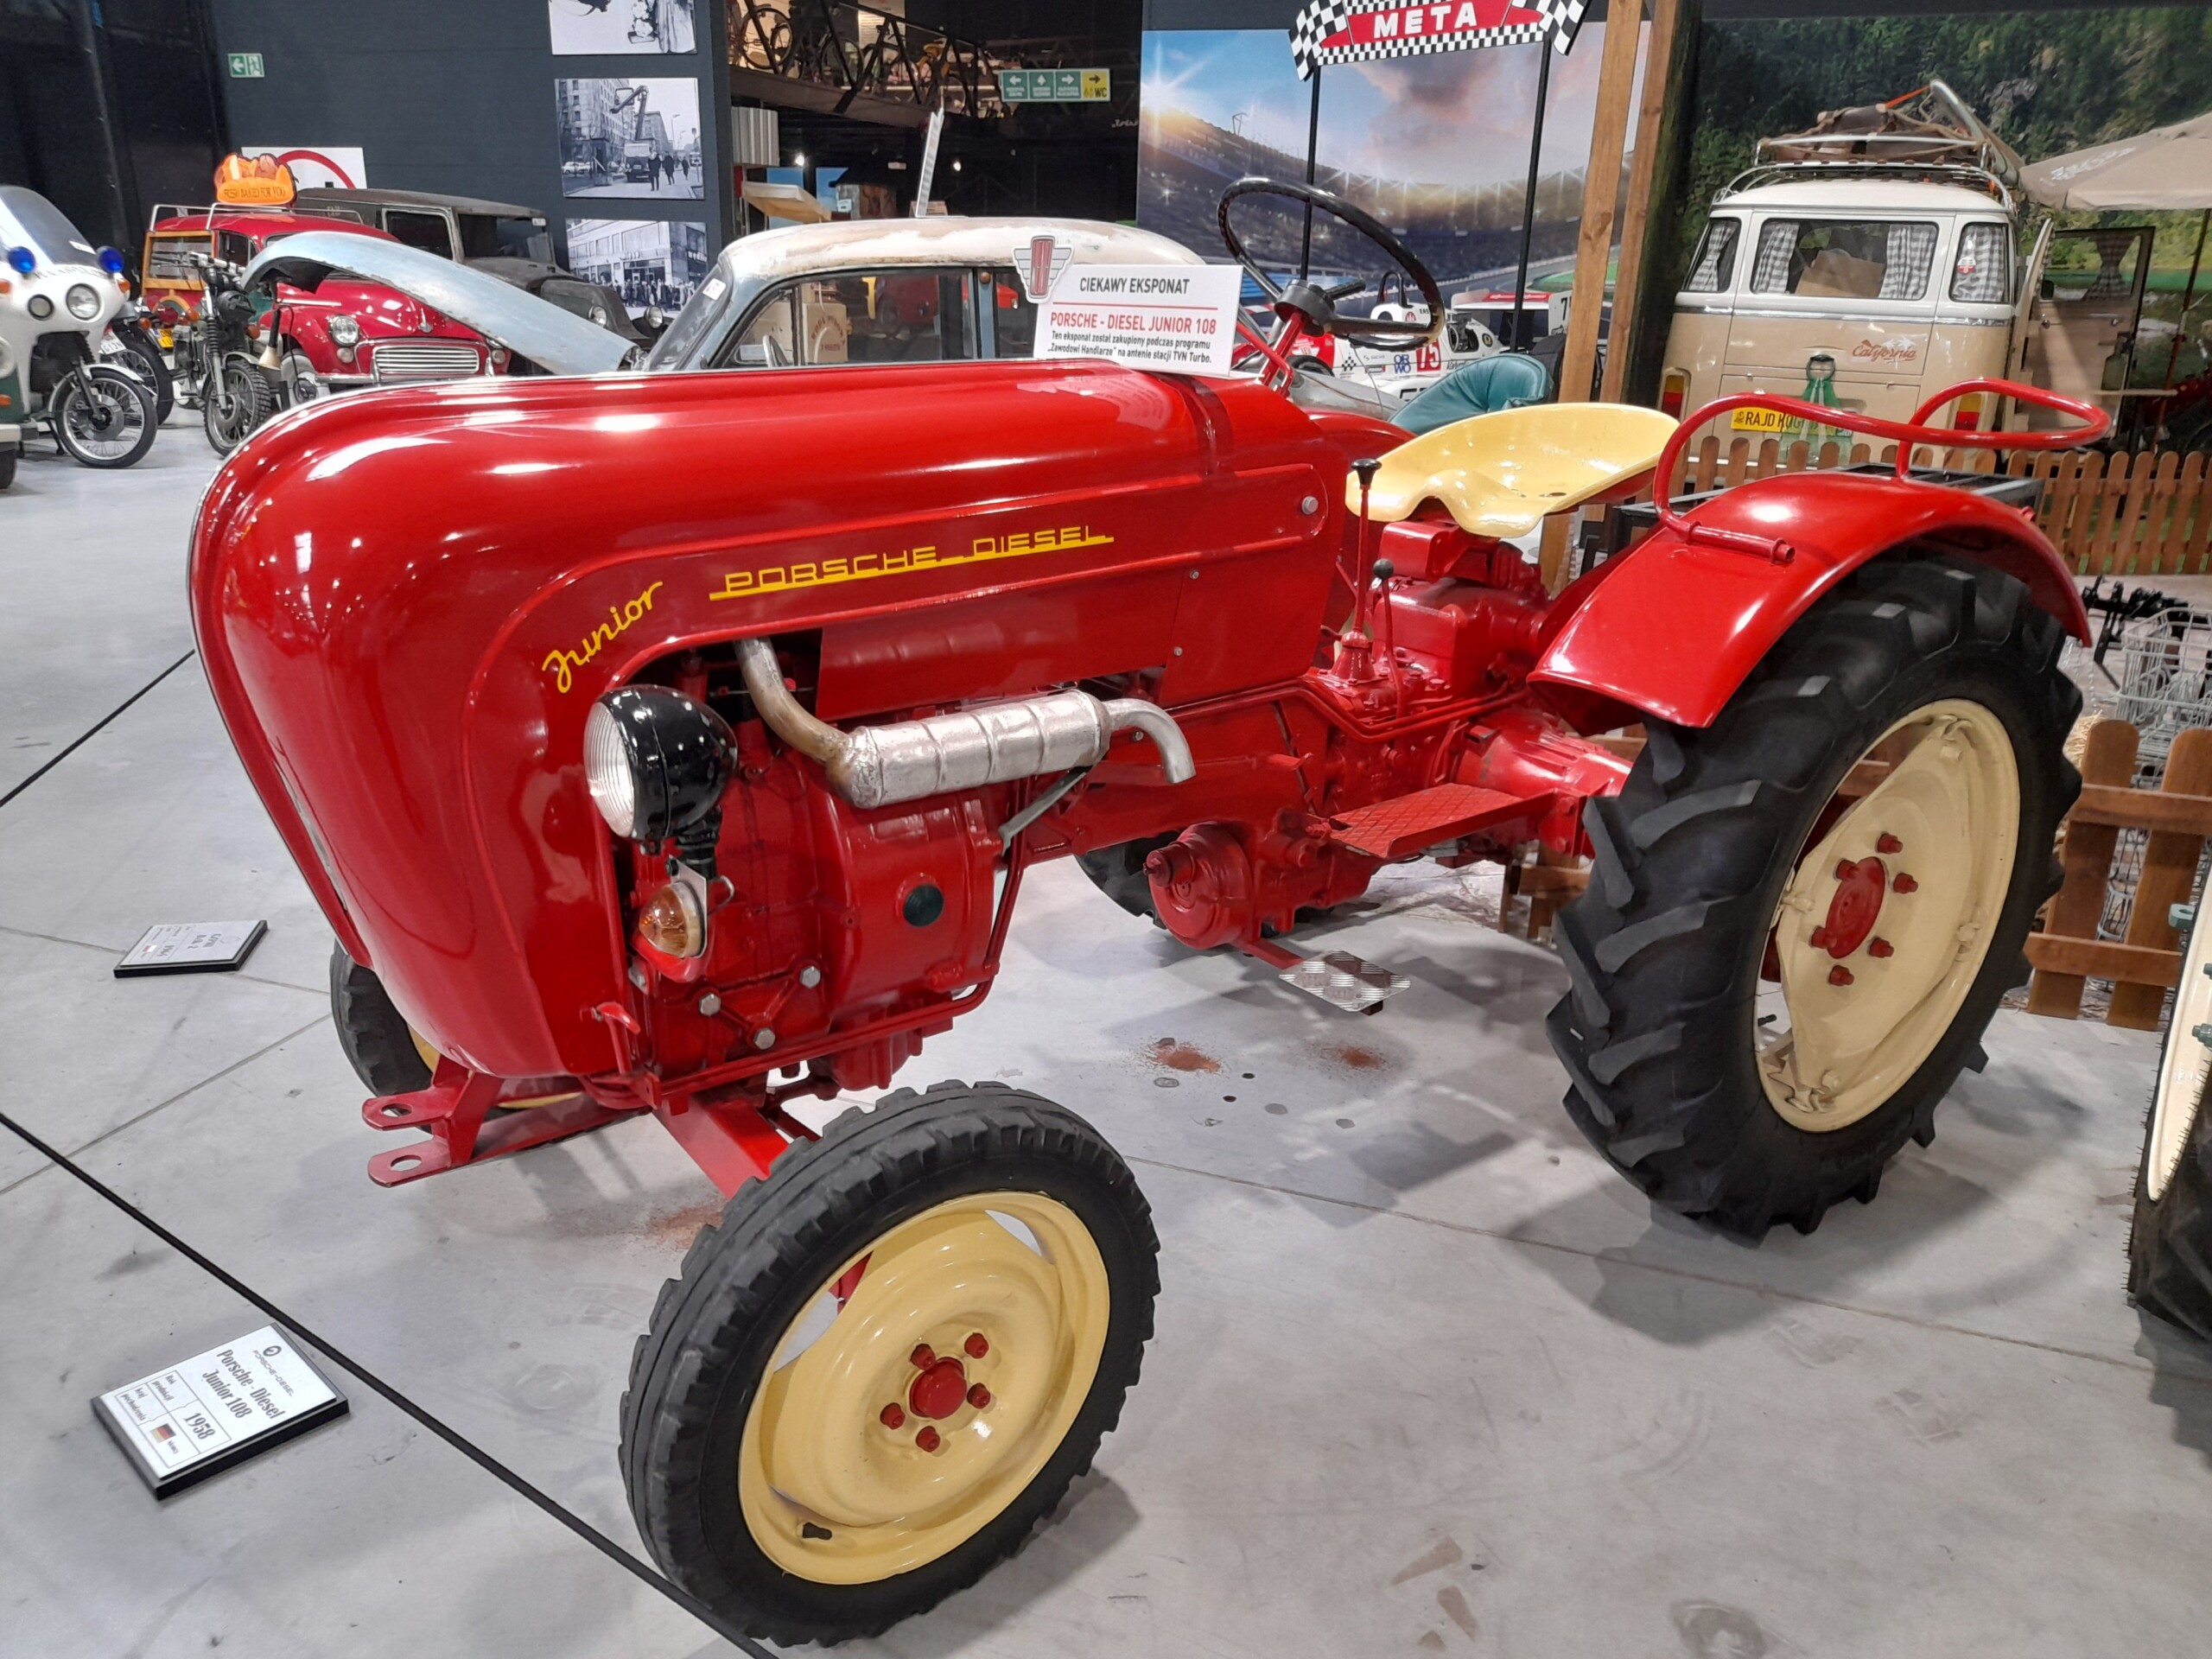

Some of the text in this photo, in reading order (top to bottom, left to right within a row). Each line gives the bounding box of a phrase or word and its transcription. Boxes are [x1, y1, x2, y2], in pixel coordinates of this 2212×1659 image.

[1373, 3, 1477, 39] META
[1094, 87, 1108, 98] WC
[1079, 276, 1190, 295] CIEKAWY EKSPONAT
[1050, 312, 1098, 329] PORSCHE
[1107, 314, 1146, 332] DIESEL
[1148, 316, 1192, 334] JUNIOR
[1196, 318, 1217, 334] 108
[1052, 330, 1211, 351] Ten eksponat został zakupiony podczas programu
[1852, 339, 1917, 363] California
[1117, 348, 1126, 357] na
[1127, 349, 1152, 359] antenie
[1153, 349, 1172, 362] stacji
[1173, 350, 1188, 362] TVN
[1189, 351, 1212, 364] Turbo.
[1745, 411, 1776, 427] RAJD
[724, 524, 1115, 594] PORSCHE DIESEL
[541, 580, 664, 693] Junior
[201, 1369, 253, 1419] Junior 108
[216, 1349, 254, 1387] Porsche
[250, 1388, 286, 1420] Diesel
[184, 1412, 216, 1440] 1958
